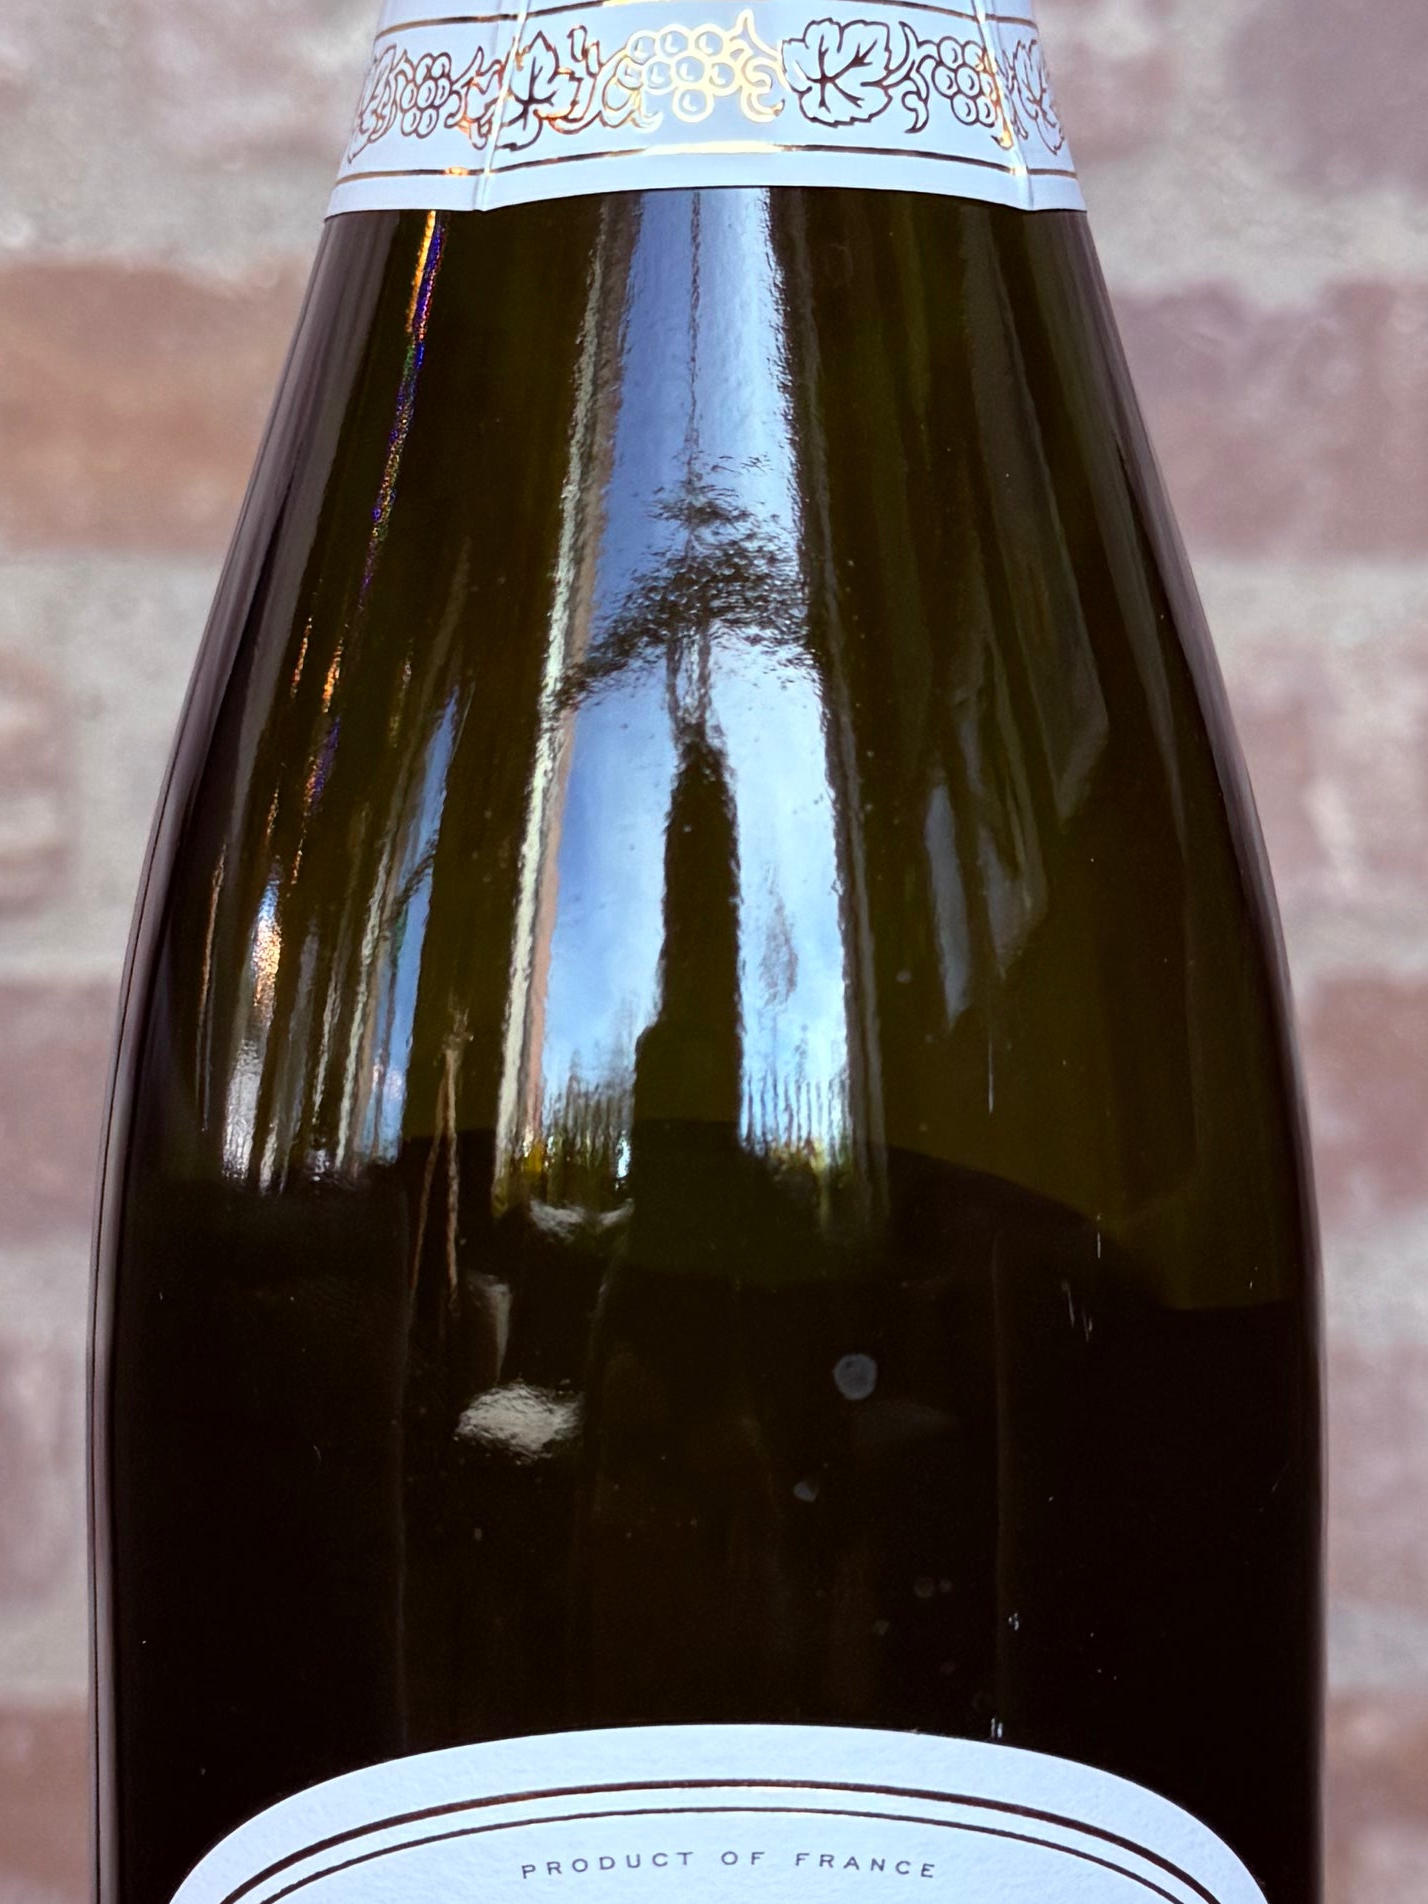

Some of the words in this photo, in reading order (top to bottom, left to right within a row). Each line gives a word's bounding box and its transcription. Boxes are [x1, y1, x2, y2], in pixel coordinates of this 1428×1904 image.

[521, 1850, 694, 1880] PRODUCT
[720, 1850, 767, 1866] OF
[795, 1852, 937, 1879] FRANCE
